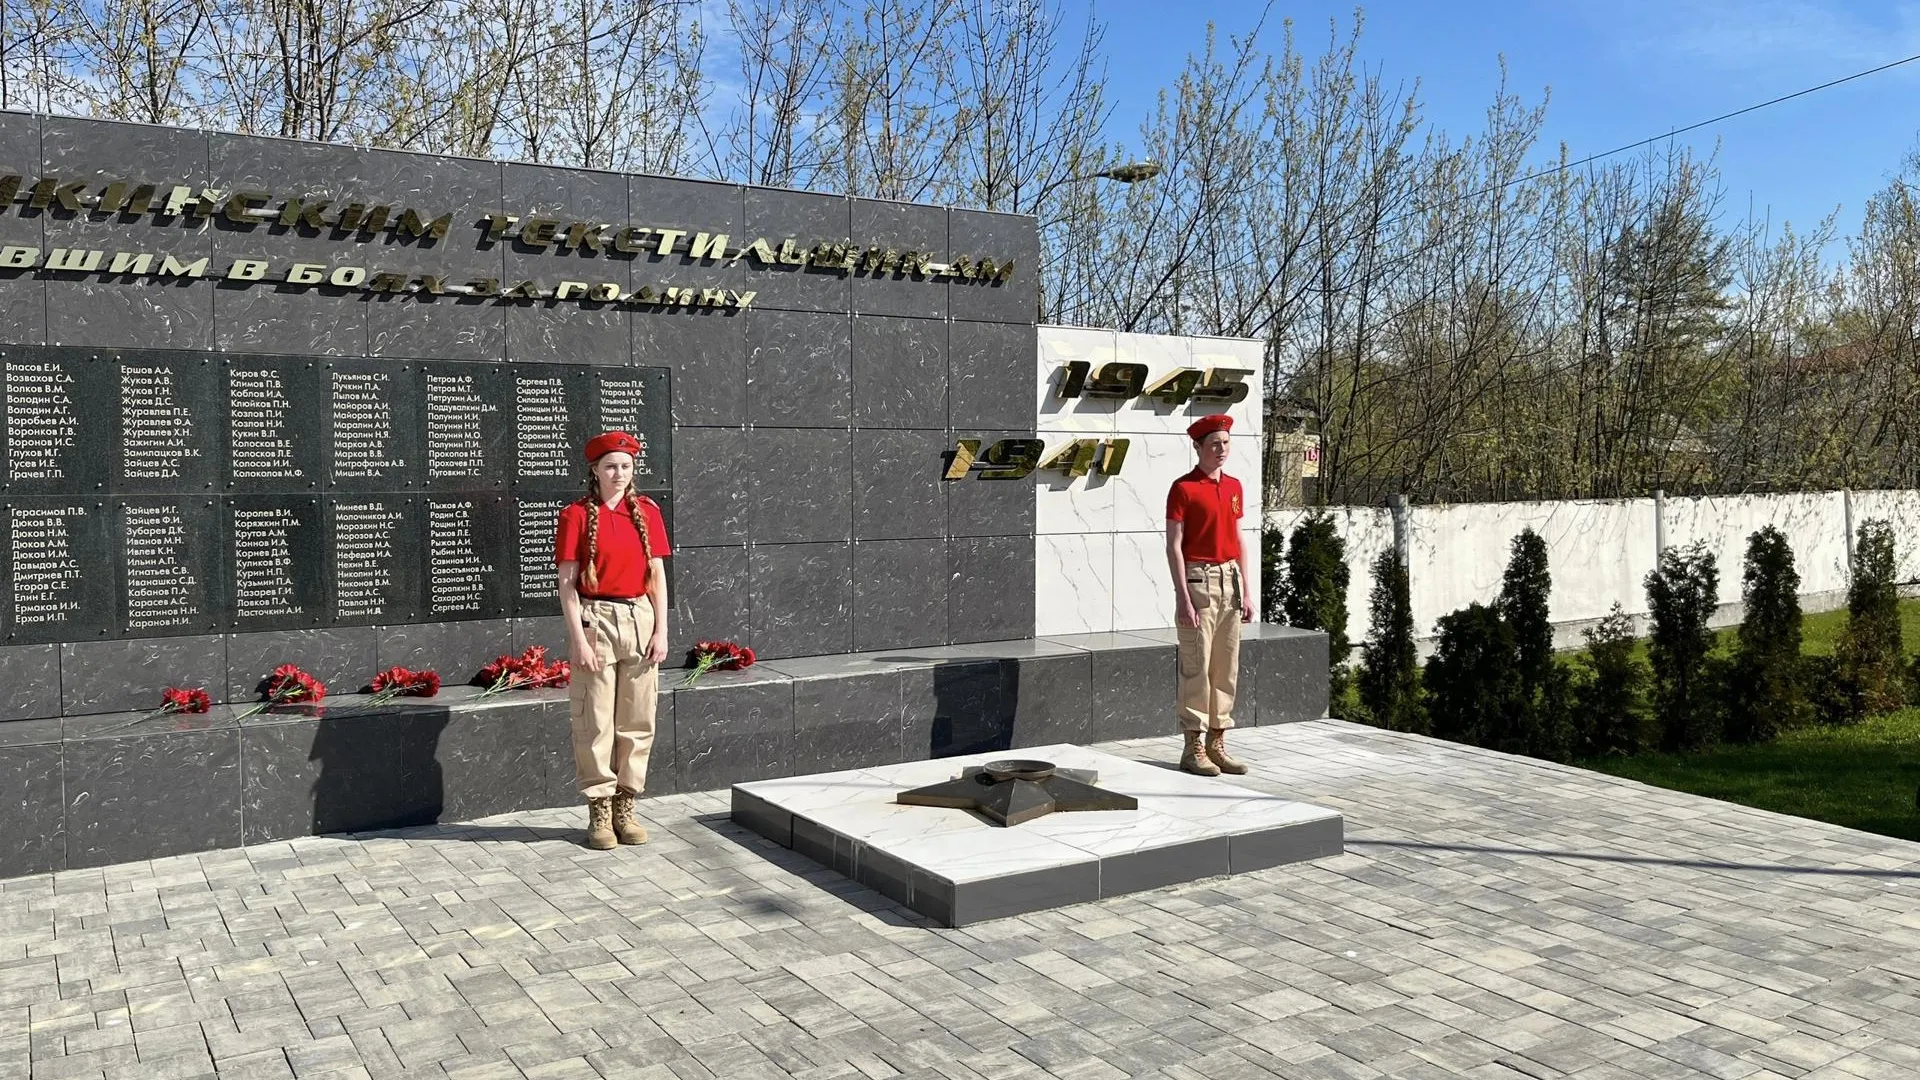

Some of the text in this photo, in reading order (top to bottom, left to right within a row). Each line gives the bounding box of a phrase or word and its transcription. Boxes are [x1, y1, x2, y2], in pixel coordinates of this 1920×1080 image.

[484, 213, 1016, 284] ТЕКСТИЛЬЩИКАМ
[227, 259, 269, 282] В
[286, 263, 450, 295] БОЯХ
[470, 277, 543, 300] ЗА
[554, 280, 759, 309] РОДИНУ
[5, 362, 64, 372] Власов Е.И.
[120, 364, 174, 376] Ершов А.А.
[229, 368, 258, 380] Киров
[331, 372, 371, 383] Лукьянов
[120, 375, 173, 387] Жуков А.В.
[230, 379, 264, 388] Климов
[1054, 360, 1256, 405] 1945
[6, 383, 66, 394] Волков В.М.
[120, 385, 173, 398] Жуков Г.Н.
[7, 405, 71, 416] Володин А.Г.
[121, 406, 192, 419] Журавлев П.Е.
[332, 401, 372, 412] Майоров
[231, 409, 264, 418] Козлов
[332, 411, 372, 422] Майоров
[7, 415, 80, 428] Воробьев А.И.
[231, 419, 264, 428] Козлов
[7, 426, 77, 439] Воронков Г.В.
[122, 427, 193, 439] Журавлев Х.Н.
[8, 437, 76, 449] Воронов И.С.
[166, 438, 187, 447] А.И.
[231, 438, 275, 448] Колосков
[333, 440, 367, 451] Марков
[9, 458, 58, 471] Гусев И.Е.
[123, 458, 181, 468] Зайцев А.С.
[232, 459, 271, 468] Колосов
[334, 458, 389, 470] Митрофанов
[941, 437, 1131, 482] 1941
[11, 506, 88, 520] Герасимов П.В.
[125, 506, 160, 516] Зайцев
[234, 509, 273, 520] Королев
[10, 517, 66, 529] Дюков В.В.
[125, 516, 160, 526] Зайцев
[234, 519, 279, 530] Коряжкин
[11, 528, 70, 540] Дюков Н.М.
[125, 526, 166, 538] Зубарев
[235, 529, 266, 540] Крутов
[126, 537, 161, 546] Иванов
[235, 549, 269, 560] Корнев
[12, 559, 79, 572] Давыдов А.С.
[12, 569, 83, 583] Дмитриев П.Т.
[127, 568, 170, 577] Игнатьев
[236, 568, 264, 580] Курин
[14, 580, 70, 594] Егоров С.Е.
[236, 578, 274, 590] Кузьмин
[128, 587, 169, 597] Кабанов
[14, 601, 81, 615] Ермаков И.И.
